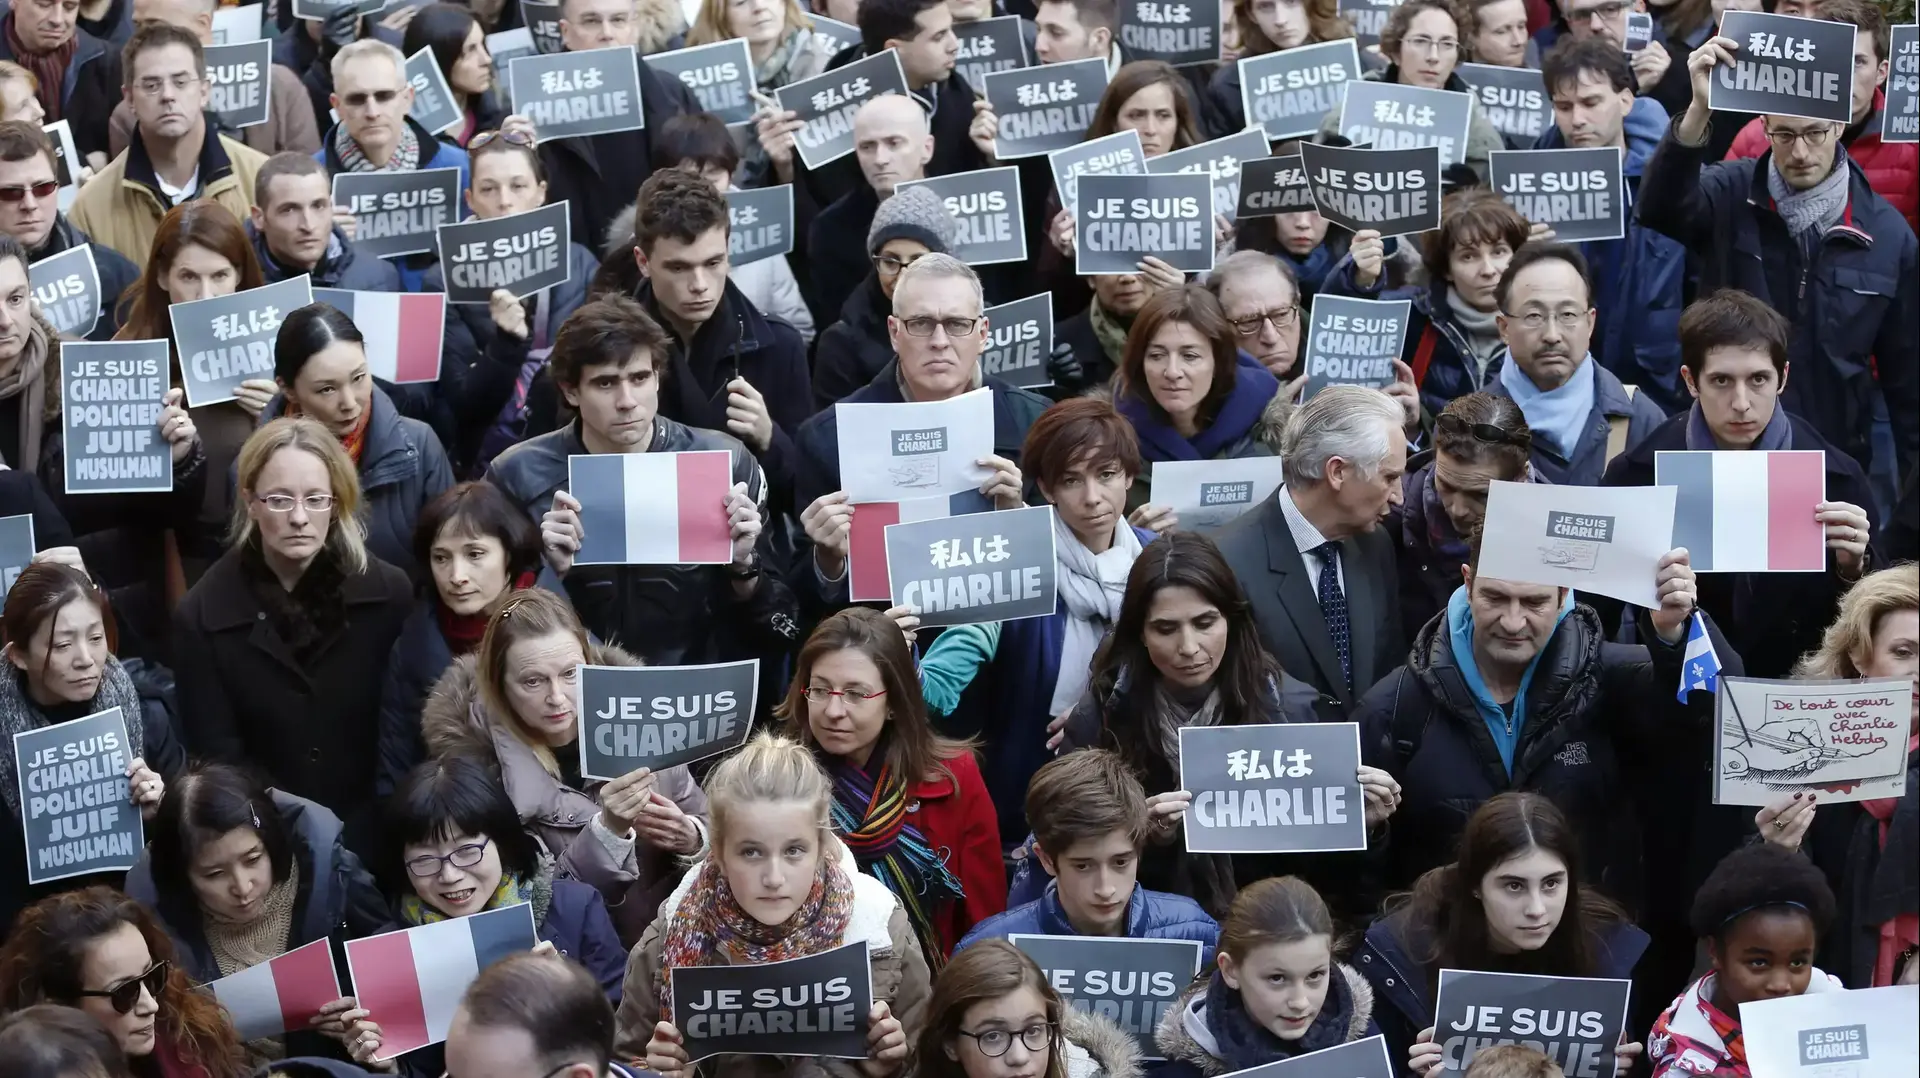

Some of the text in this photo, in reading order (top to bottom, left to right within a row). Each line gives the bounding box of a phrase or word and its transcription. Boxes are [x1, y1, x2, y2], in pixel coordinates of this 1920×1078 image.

[1136, 2, 1190, 23] 私は
[533, 20, 561, 38] JE
[1122, 24, 1211, 52] CHARLIE
[1748, 31, 1816, 62] 私は
[541, 67, 604, 94] 私は
[679, 62, 740, 88] SUIS
[1254, 62, 1347, 95] JE SUIS
[1719, 60, 1840, 102] CHARLIE
[210, 81, 261, 112] RLIE
[811, 77, 872, 111] 私は
[1016, 79, 1078, 107] 私は
[1481, 86, 1543, 109] SUIS
[520, 91, 629, 127] CHARLIE
[1373, 100, 1436, 126] 私は
[1088, 148, 1134, 171] SUIS
[1274, 168, 1306, 187] 私
[1314, 167, 1426, 192] JE SUIS
[1501, 170, 1608, 192] JE SUIS
[349, 187, 446, 214] JE SUIS
[944, 190, 1007, 216] SUIS
[1087, 199, 1125, 219] JE
[1131, 197, 1200, 219] SUIS
[1315, 186, 1428, 222] CHARLIE
[1505, 192, 1611, 223] HARLIE
[355, 204, 447, 241] HARLIE
[452, 226, 557, 263] JE SUIS
[728, 223, 782, 256] RLIE
[1085, 221, 1202, 252] CHARLIE
[452, 245, 558, 288] CHARLIE
[211, 306, 282, 341] 私は
[1320, 314, 1398, 334] JE SUIS
[1315, 331, 1397, 356] CHARLIE
[71, 360, 158, 377] JE SUIS
[981, 340, 1041, 375] RLIE
[69, 378, 160, 401] CHARLIE
[85, 430, 151, 454] JUIF
[897, 430, 942, 441] JE SUIS
[897, 439, 942, 452] CHARLIE
[75, 456, 162, 480] MUSULMAN
[1206, 484, 1248, 494] JE SUIS
[1206, 492, 1248, 503] CHARLIE
[1554, 524, 1607, 539] CHARLIE
[1555, 515, 1607, 528] JE SUIS
[929, 534, 1011, 569] 私は
[902, 566, 1042, 615] CHARLIE
[596, 690, 737, 720] JE SUIS
[1772, 700, 1795, 710] De
[1800, 699, 1838, 710] tout
[1833, 711, 1869, 719] avec
[594, 712, 738, 757] CHARLIE
[1564, 741, 1580, 750] THE
[1831, 732, 1886, 745] Hebdo
[28, 732, 119, 768] JE SUIS
[1553, 750, 1582, 761] NORTH
[1564, 757, 1584, 766] FACE
[28, 750, 126, 793] CHARLIE
[1226, 748, 1314, 781] 私は
[31, 778, 132, 819] POLICIER
[1194, 786, 1348, 828] CHARLIE
[49, 806, 119, 842] JUIF
[38, 832, 133, 869] MUSULMAN
[688, 977, 851, 1011] JE SUIS
[1083, 969, 1176, 997] SUIS
[686, 1003, 856, 1039] CHARLIE
[1450, 1005, 1604, 1038] JE SUIS
[1805, 1030, 1859, 1045] JE SUIS
[1806, 1041, 1862, 1060] CHARLIE
